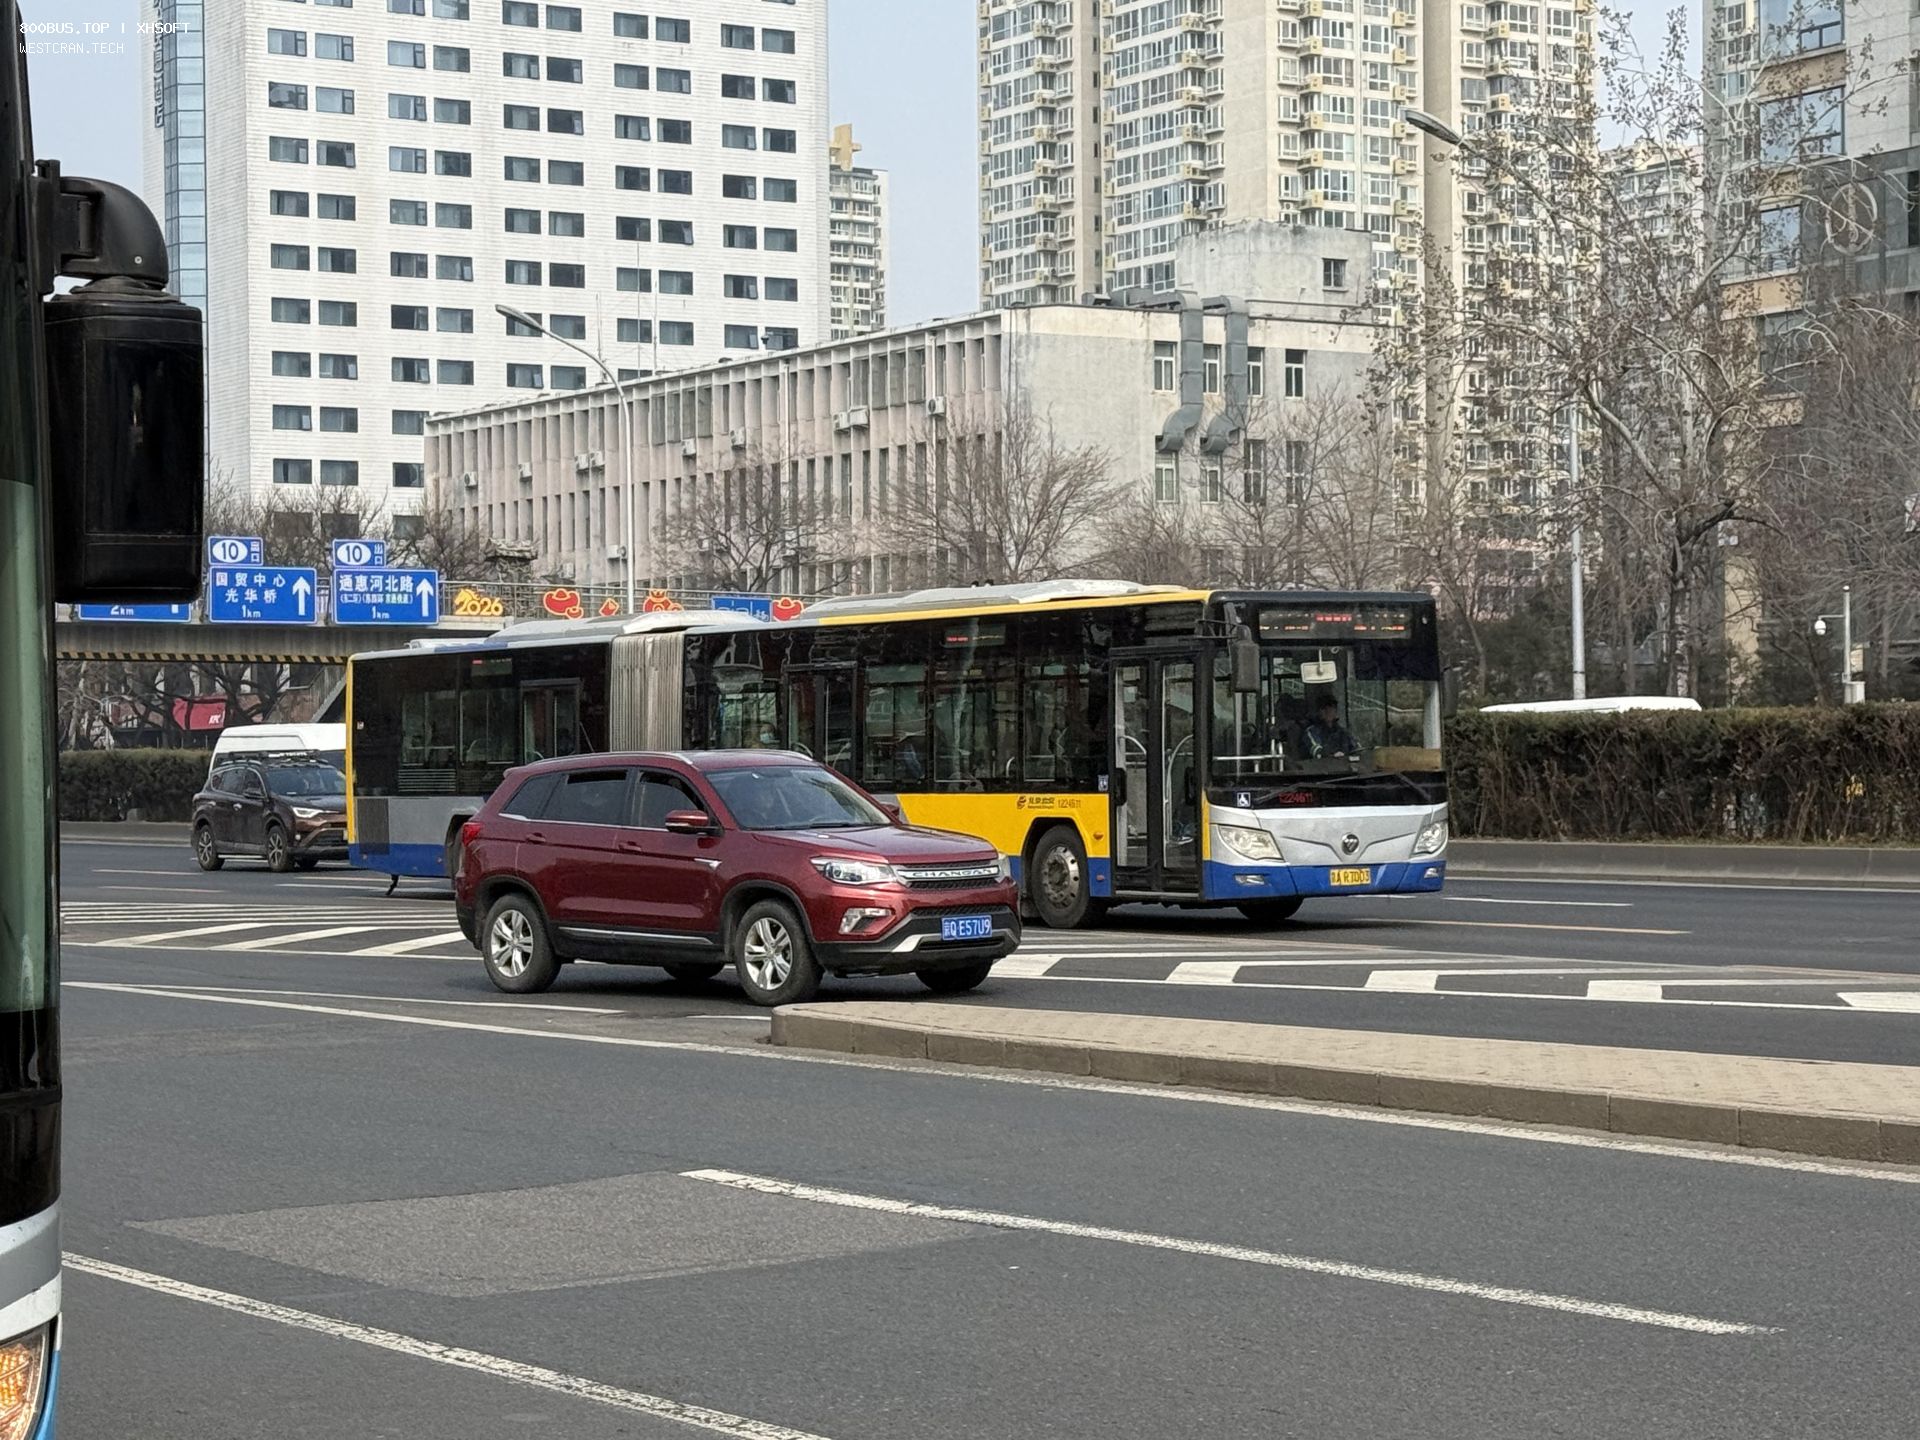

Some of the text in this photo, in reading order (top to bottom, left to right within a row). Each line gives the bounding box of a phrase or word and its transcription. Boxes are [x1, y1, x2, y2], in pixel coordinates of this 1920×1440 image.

[221, 542, 239, 560] 10
[345, 545, 363, 563] 10
[374, 544, 383, 565] 出口
[215, 572, 286, 588] 国贸中心
[339, 574, 414, 593] 通惠河北路
[225, 588, 277, 604] 光华桥
[241, 604, 262, 618] 1km
[371, 605, 390, 619] 1km
[455, 597, 503, 616] 2026
[912, 868, 992, 877] CHANGAN
